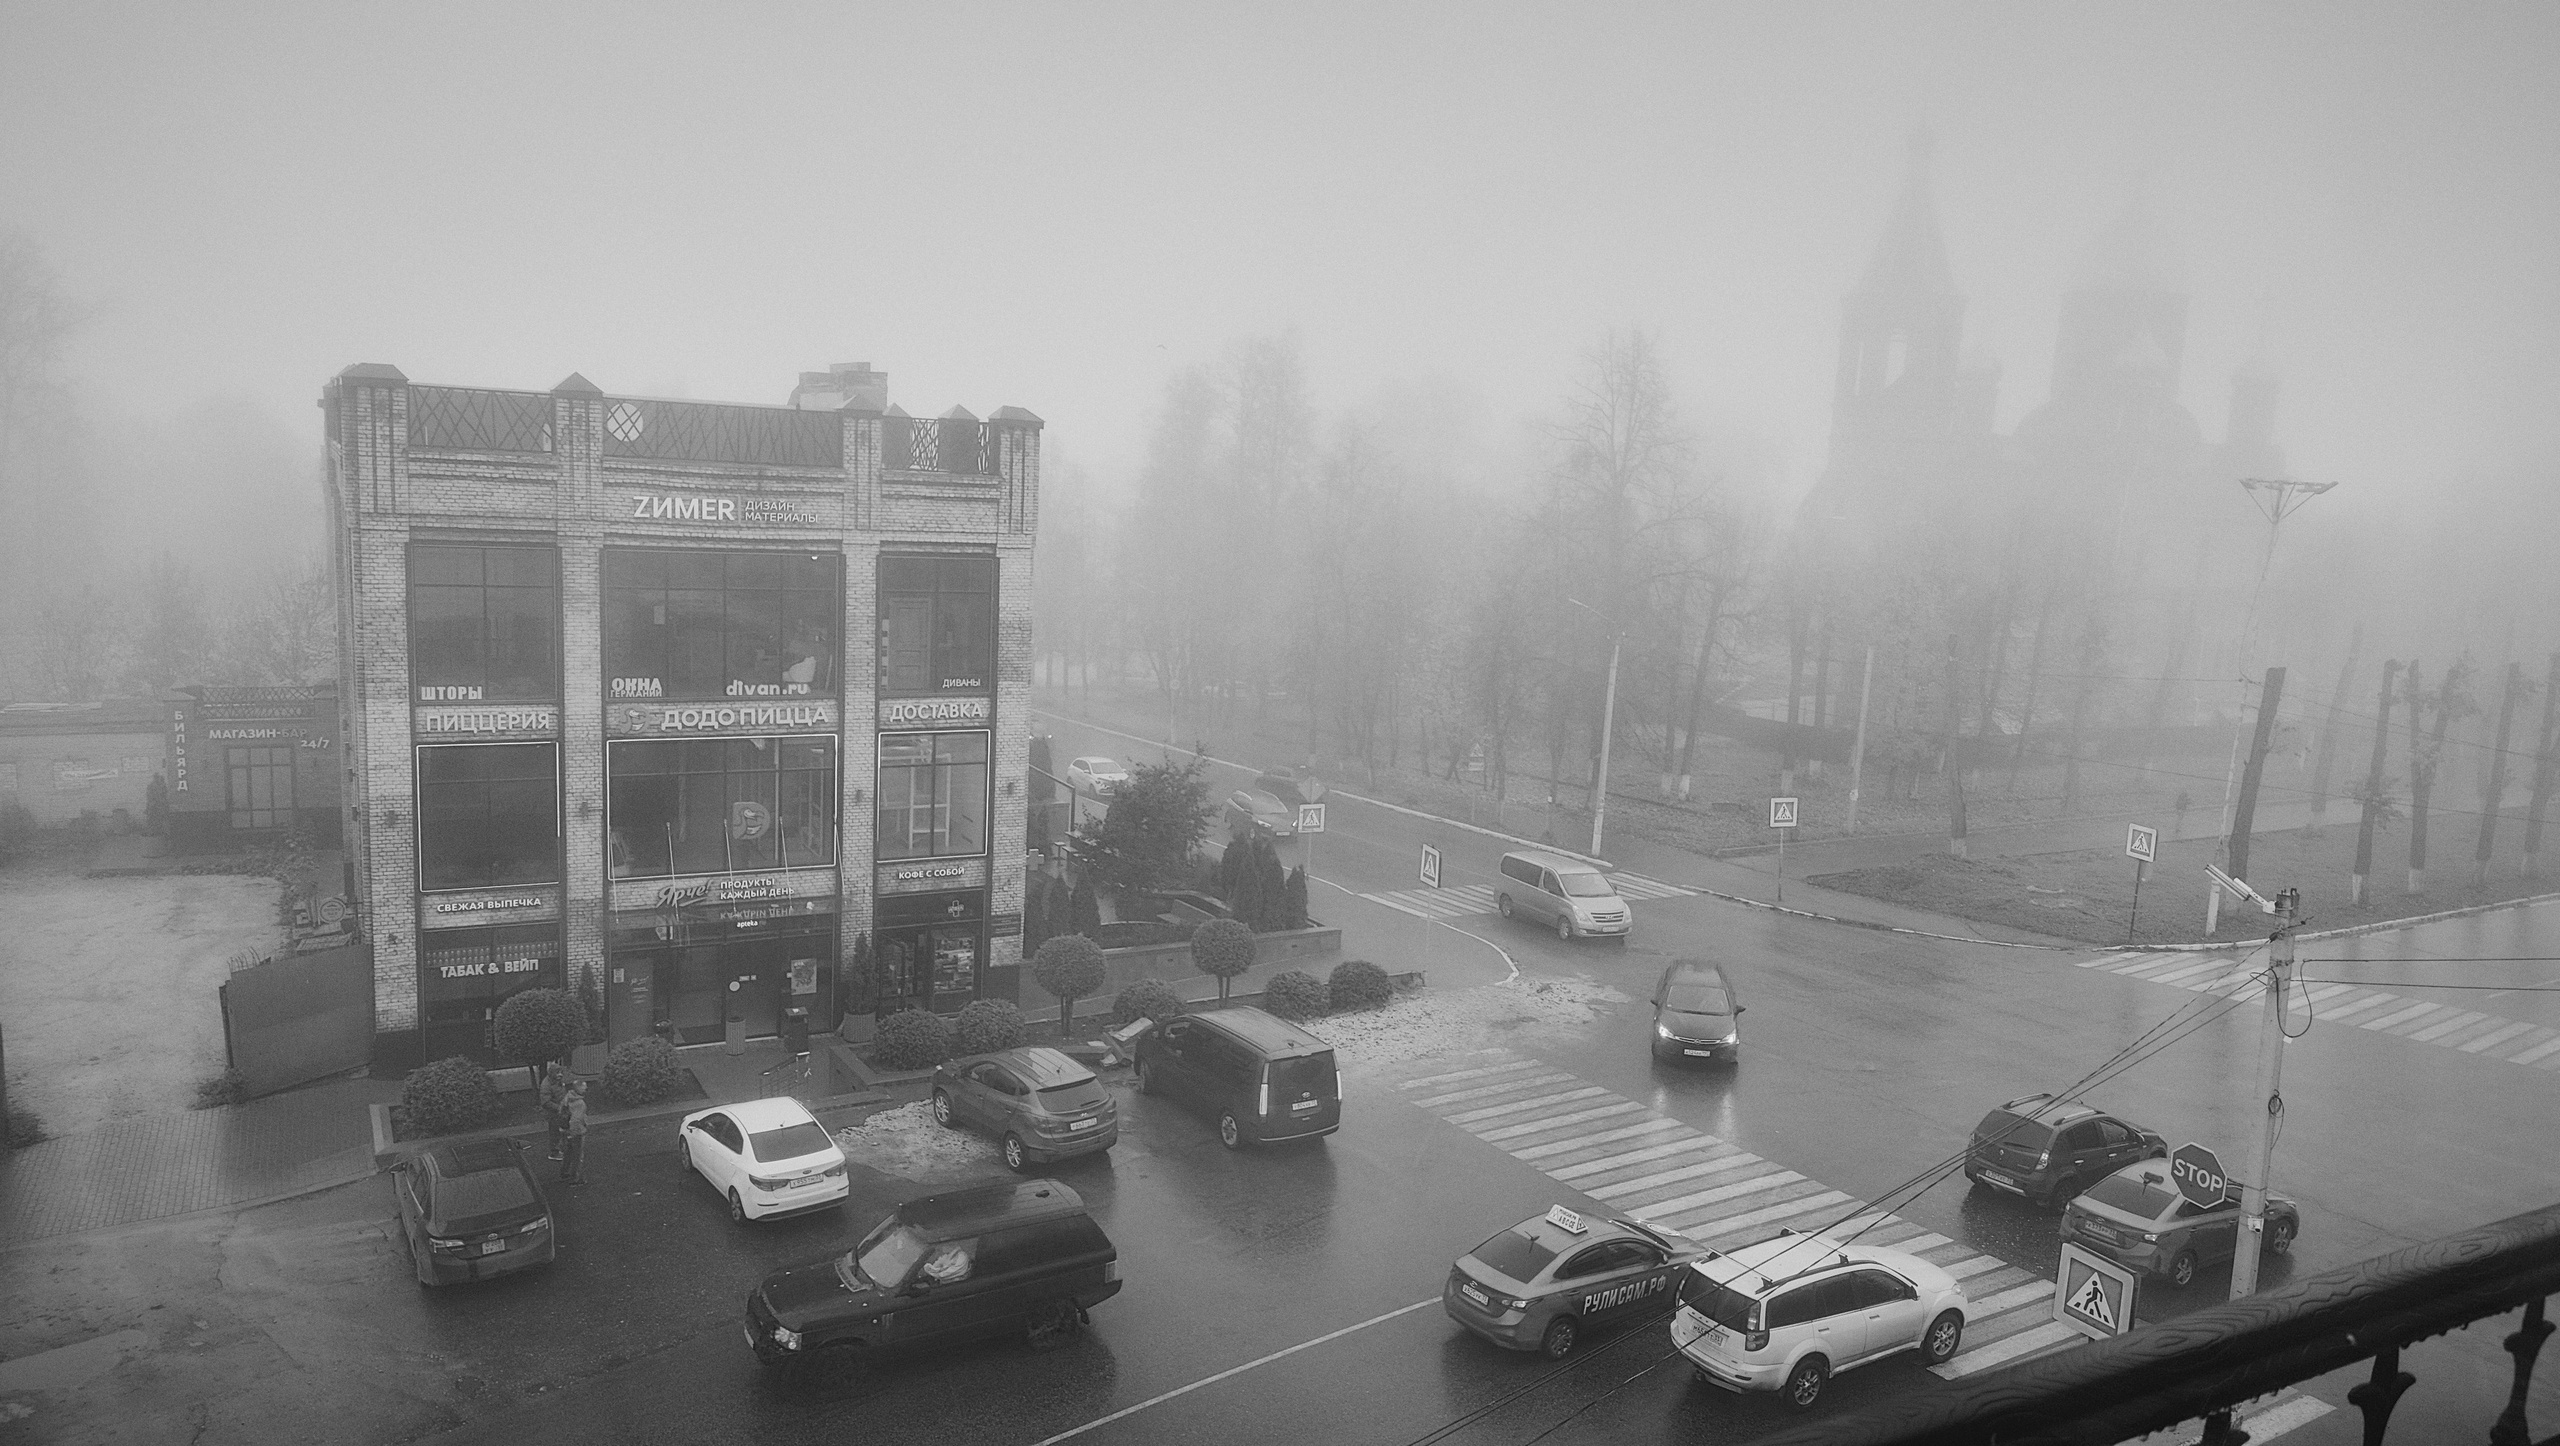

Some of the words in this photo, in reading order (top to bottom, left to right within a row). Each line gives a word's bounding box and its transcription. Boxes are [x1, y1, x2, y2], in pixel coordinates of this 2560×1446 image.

[745, 500, 795, 512] ДИЗАЙН
[745, 512, 819, 523] МАТЕРИАЛЫ
[611, 677, 663, 691] ОКНА
[725, 679, 809, 696] divan.ru
[942, 678, 981, 688] ДИВАНЫ
[421, 686, 483, 700] ШТОРЫ
[661, 709, 735, 730] ДОДО
[740, 706, 829, 727] ПИЦЦА
[889, 702, 983, 722] ДОСТАВКА
[426, 712, 550, 734] ПИЦЦЕРИЯ
[301, 737, 330, 749] 24/7
[174, 710, 188, 792] БИЛЬЯРД
[898, 869, 924, 880] КОФЕ
[926, 869, 932, 878] С
[934, 867, 965, 877] СОБОЙ
[720, 878, 775, 890] ПРОДУКТЫ
[720, 887, 767, 900] КАЖДЫЙ
[768, 886, 795, 898] ДЕНЬ
[437, 901, 484, 913] СВЕЖАЯ
[487, 897, 542, 909] ВЫПЕЧКА
[440, 963, 485, 979] ТАБАК
[487, 962, 500, 974] &
[504, 958, 539, 973] ВЕЙП
[2173, 1158, 2224, 1192] STOP
[1583, 1274, 1666, 1315] РУЛИСАМ.РФ
